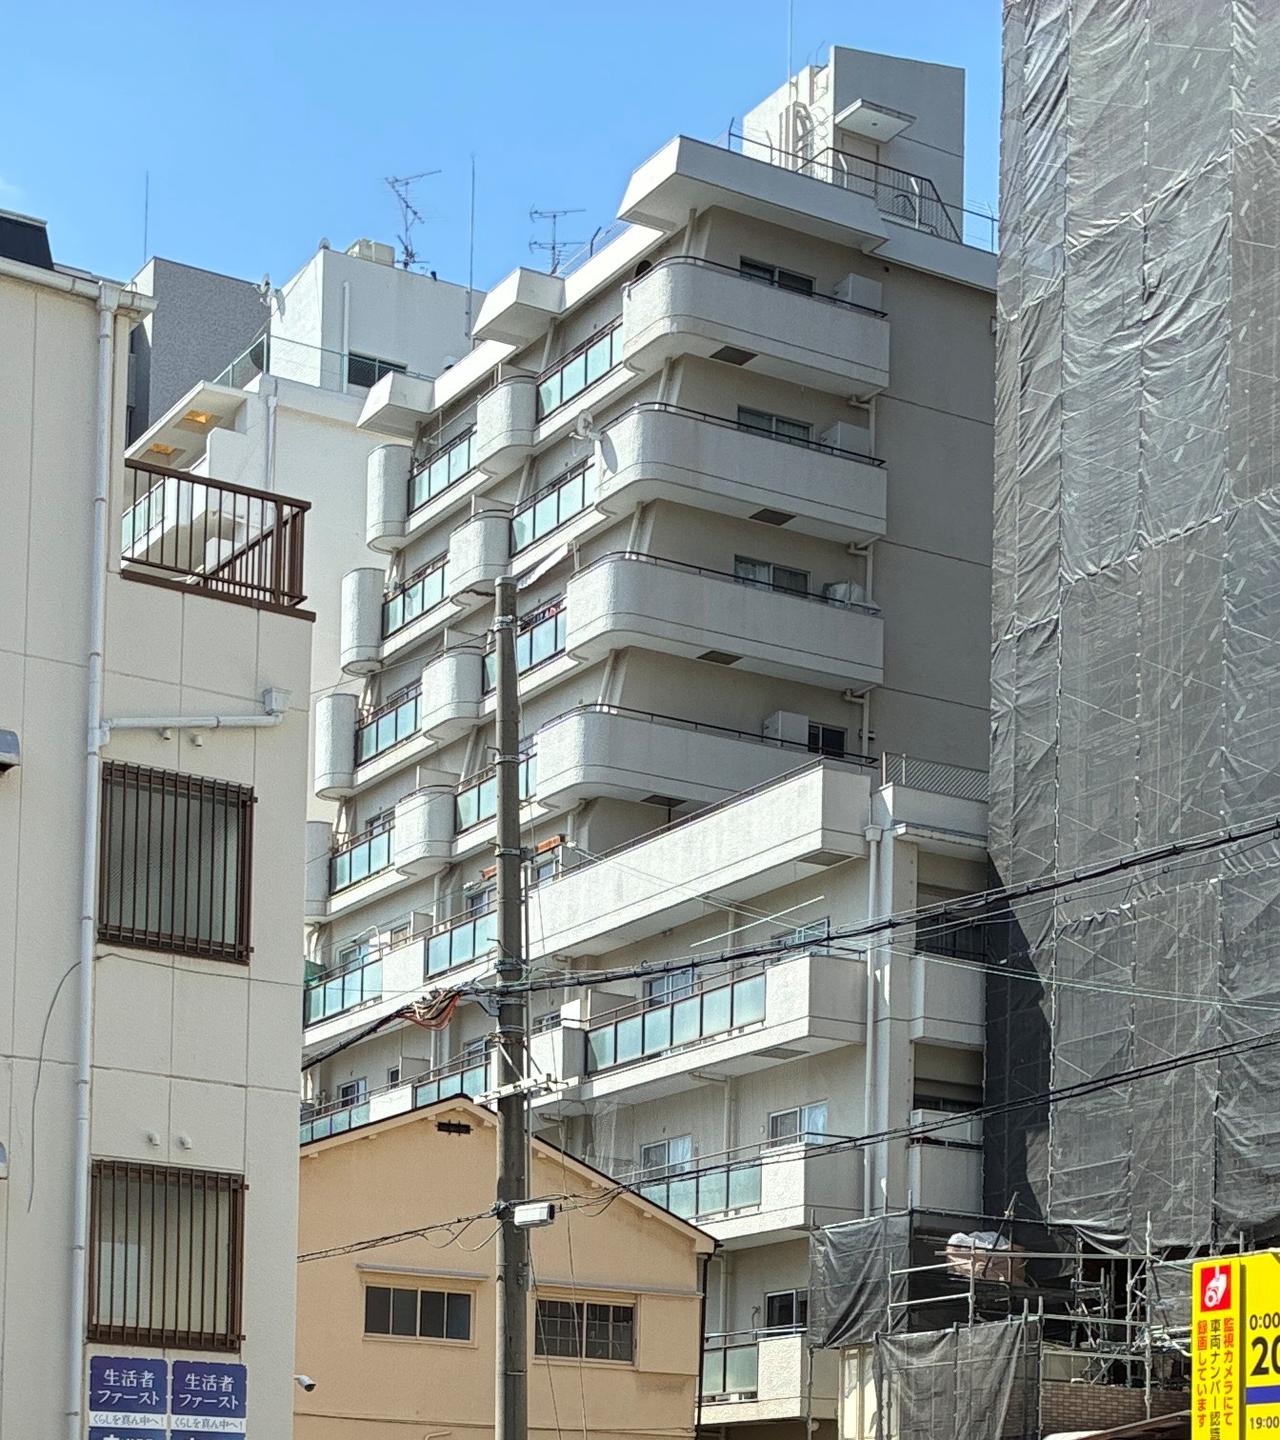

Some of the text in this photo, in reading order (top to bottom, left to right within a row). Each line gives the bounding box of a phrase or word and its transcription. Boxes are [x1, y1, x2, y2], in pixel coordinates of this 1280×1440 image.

[103, 1369, 155, 1388] 生活者
[1223, 1317, 1234, 1426] 監視カメラにて
[184, 1373, 235, 1392] 生活者
[97, 1390, 159, 1405] ファースト
[178, 1394, 239, 1410] ファースト
